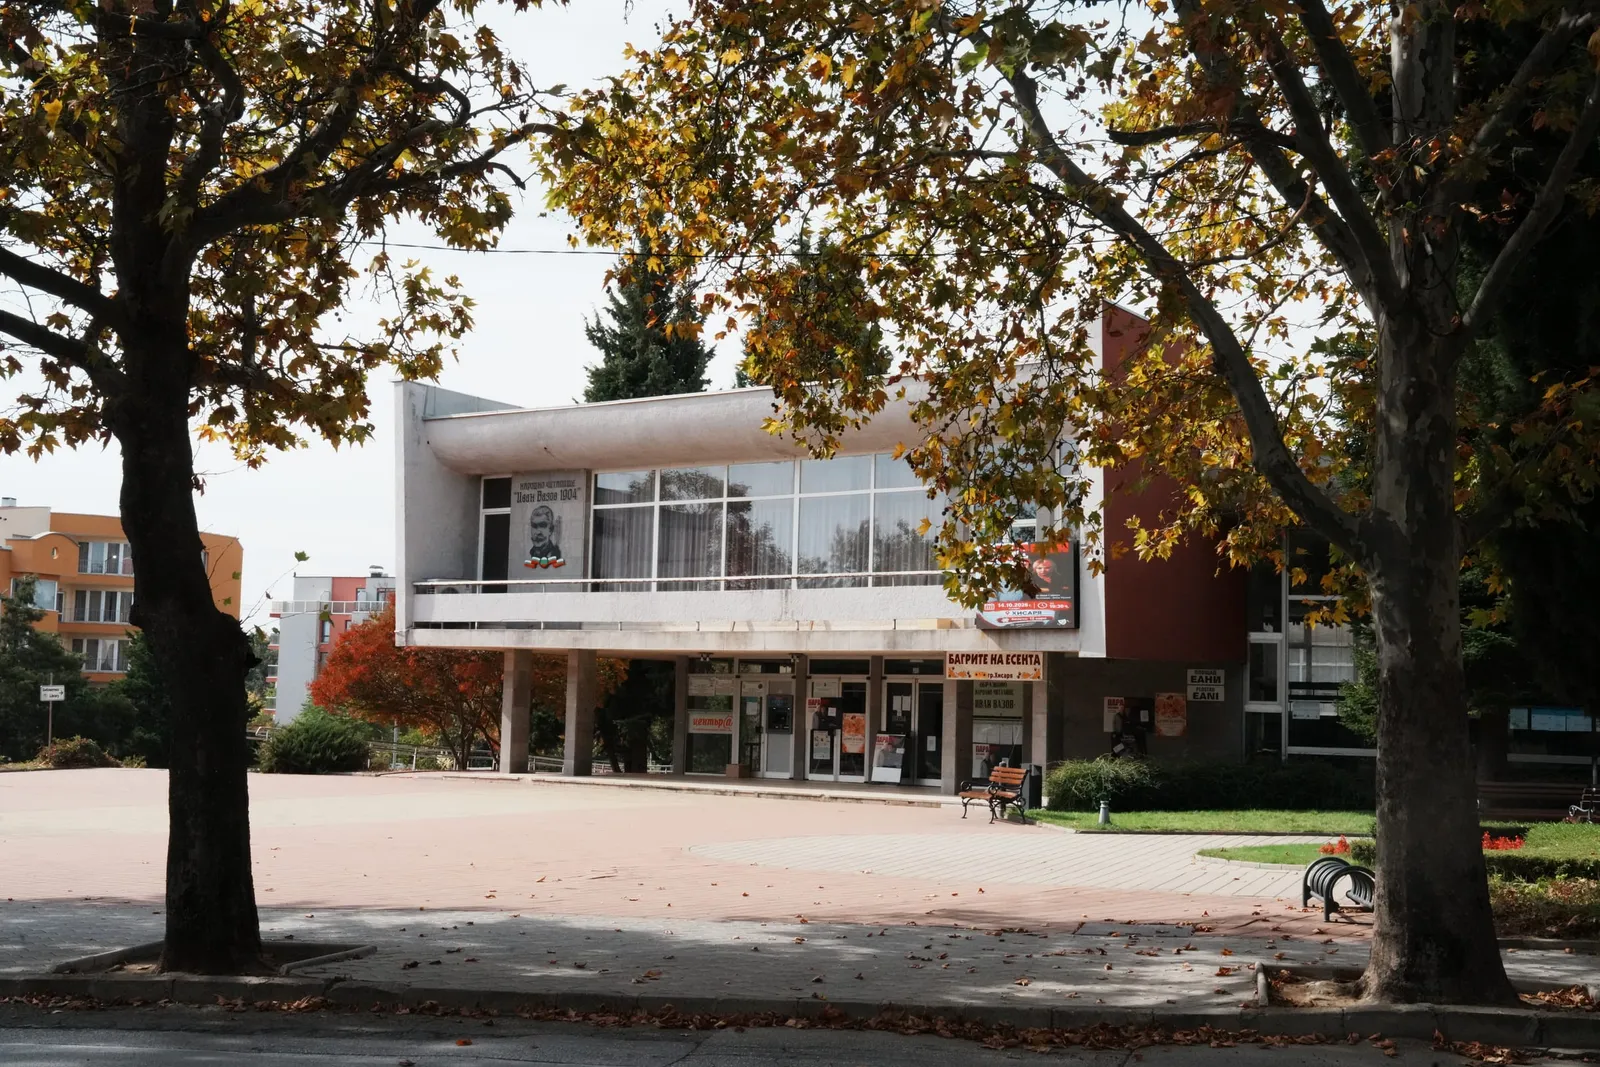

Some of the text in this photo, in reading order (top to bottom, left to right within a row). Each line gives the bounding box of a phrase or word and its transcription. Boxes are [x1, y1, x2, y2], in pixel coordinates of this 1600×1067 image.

[537, 490, 557, 502] Вазов
[948, 653, 1040, 666] БАГРИТЕ НА ЕСЕНТА
[1190, 675, 1221, 684] ЕАНИ
[1193, 692, 1219, 700] EANI
